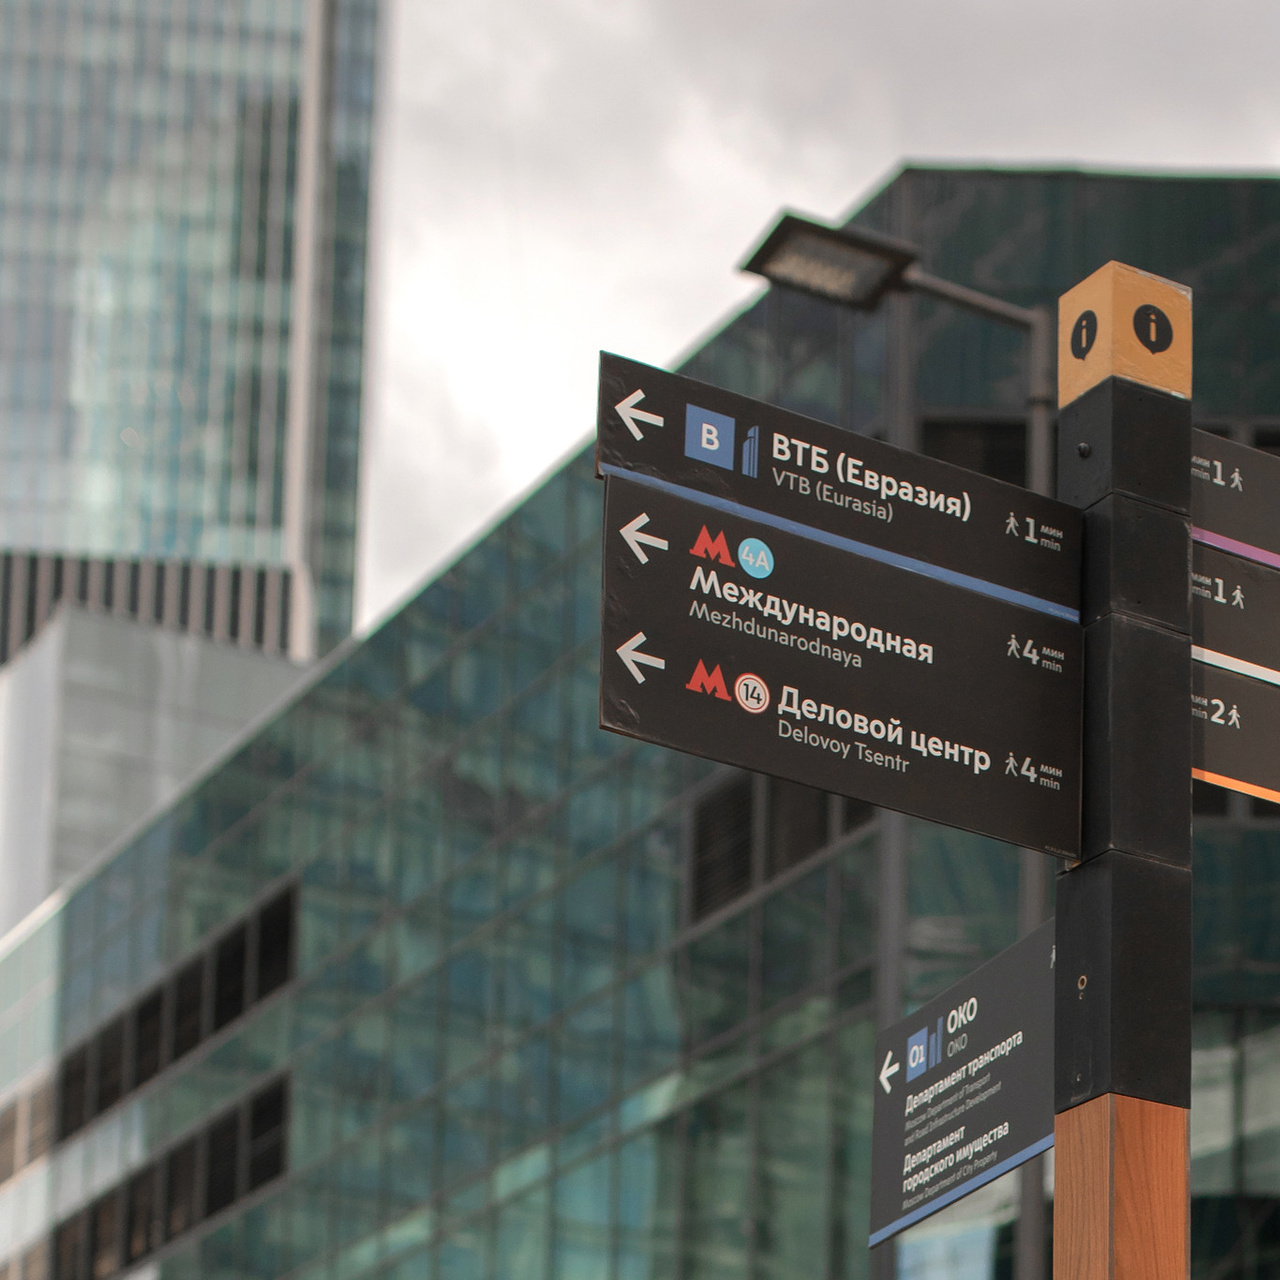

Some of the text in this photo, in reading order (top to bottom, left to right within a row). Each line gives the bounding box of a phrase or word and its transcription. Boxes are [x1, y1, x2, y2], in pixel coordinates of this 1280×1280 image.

[772, 433, 973, 521] ВТБ (Евразия)
[1212, 460, 1226, 486] 1
[772, 468, 894, 523] VTB (Eurasia)
[1025, 517, 1038, 543] 1
[1040, 523, 1063, 539] мин
[1040, 535, 1061, 552] min
[1213, 577, 1228, 603] 1
[690, 566, 934, 664] Международная
[690, 601, 862, 669] Mezhdunarodnaya
[1023, 640, 1040, 666] 4
[1042, 646, 1065, 661] мин
[1042, 657, 1062, 673] min
[742, 682, 763, 705] 14
[1210, 699, 1226, 724] 2
[777, 686, 992, 775] Деловой центр
[777, 720, 909, 773] Delovoy Tsentr
[1020, 757, 1038, 783] 4
[1040, 764, 1063, 778] мин
[1040, 775, 1061, 790] min
[946, 996, 978, 1034] ОКО
[946, 1033, 968, 1058] OKO
[905, 1031, 1023, 1117] Департамент транспорта
[902, 1121, 1009, 1194] городского имущества
[903, 1126, 966, 1176] Департамент
